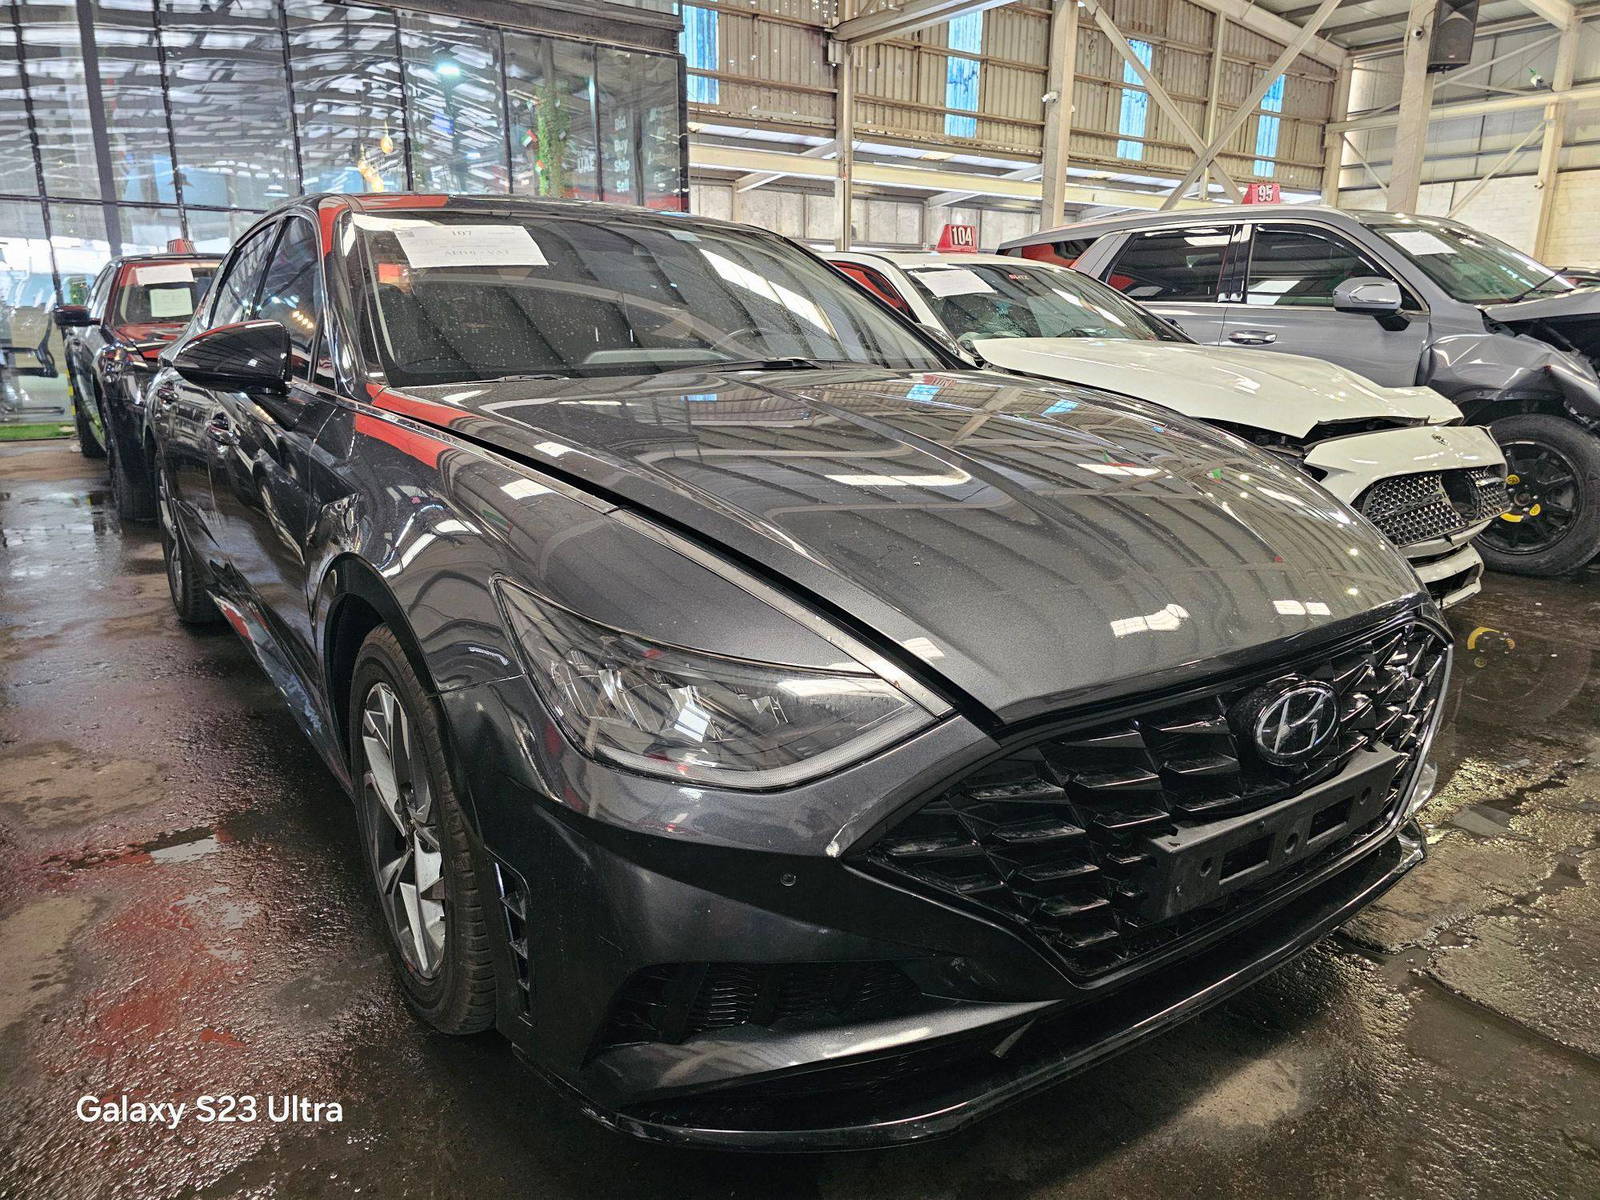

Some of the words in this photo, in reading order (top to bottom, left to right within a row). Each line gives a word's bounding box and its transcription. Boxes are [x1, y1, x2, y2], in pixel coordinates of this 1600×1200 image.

[614, 116, 627, 130] Bid
[614, 139, 629, 154] Buy
[614, 158, 631, 174] Ship
[616, 178, 630, 192] Sell
[1258, 185, 1273, 202] 95
[952, 226, 973, 245] 104
